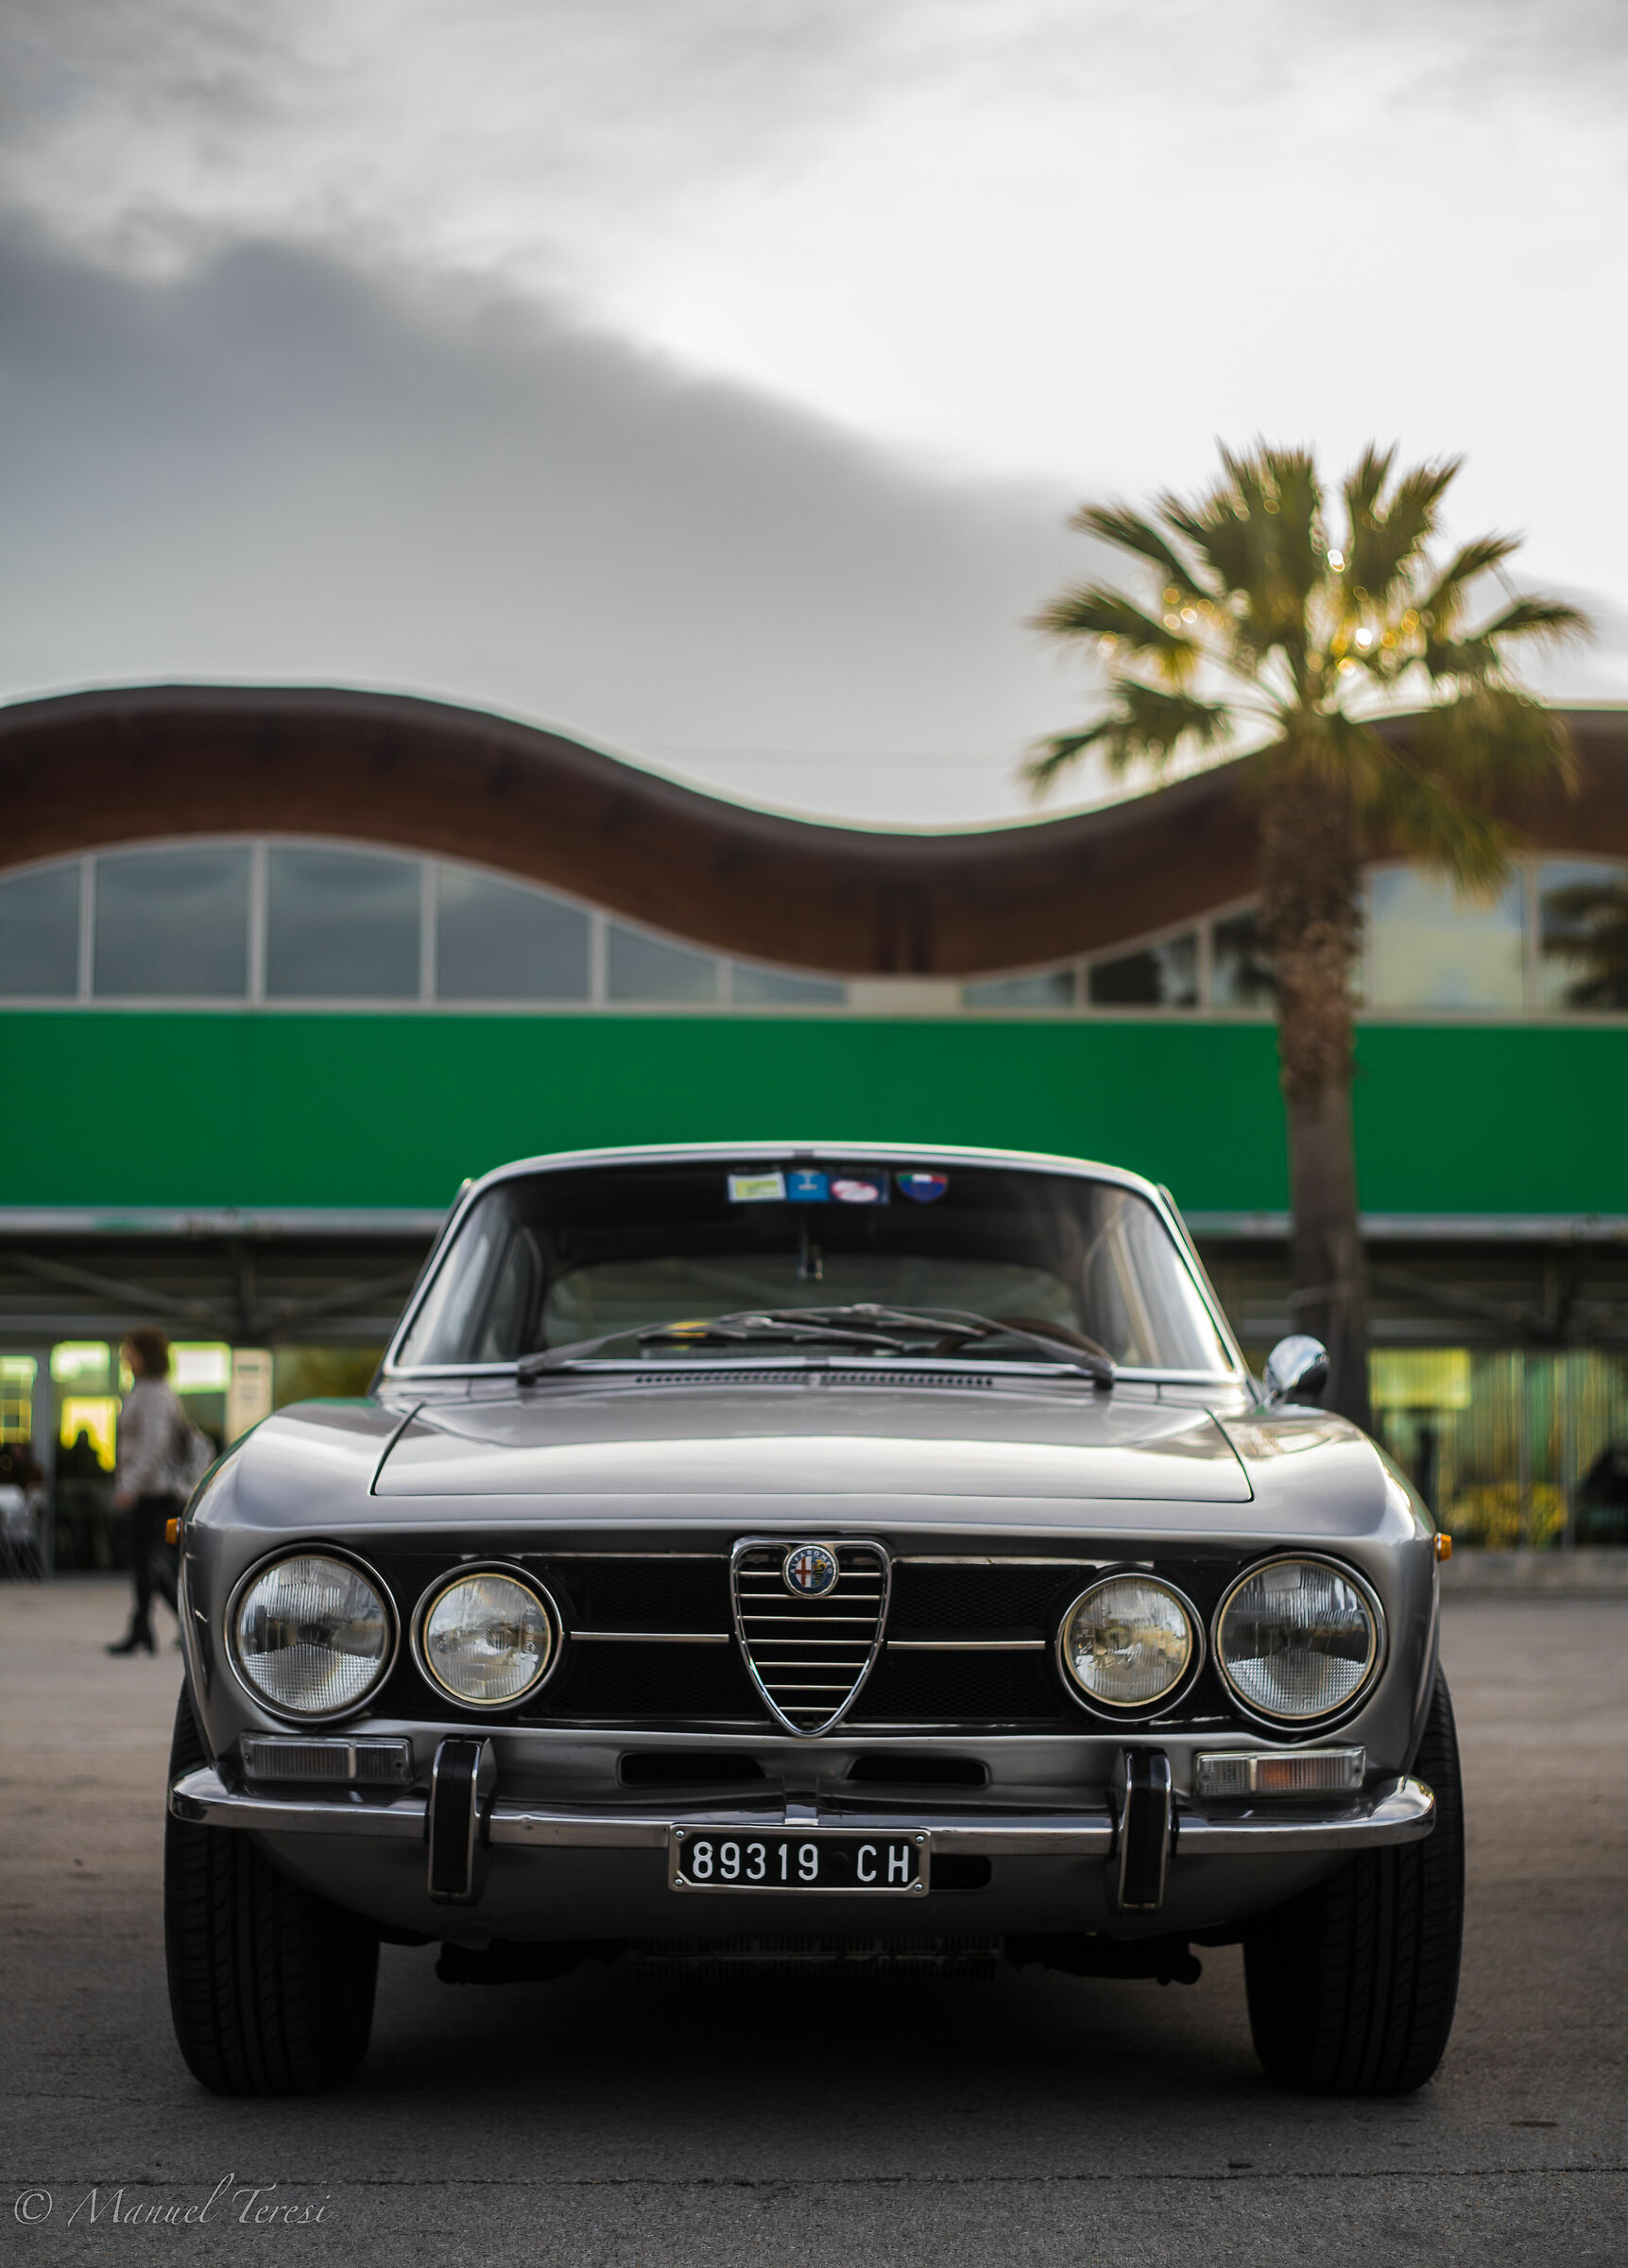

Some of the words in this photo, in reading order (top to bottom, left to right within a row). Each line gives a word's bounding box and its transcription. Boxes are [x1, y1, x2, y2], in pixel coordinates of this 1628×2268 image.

[790, 1553, 805, 1573] ALFA
[807, 1551, 832, 1573] ROMEO
[692, 1842, 818, 1880] 89319
[856, 1845, 909, 1882] CH
